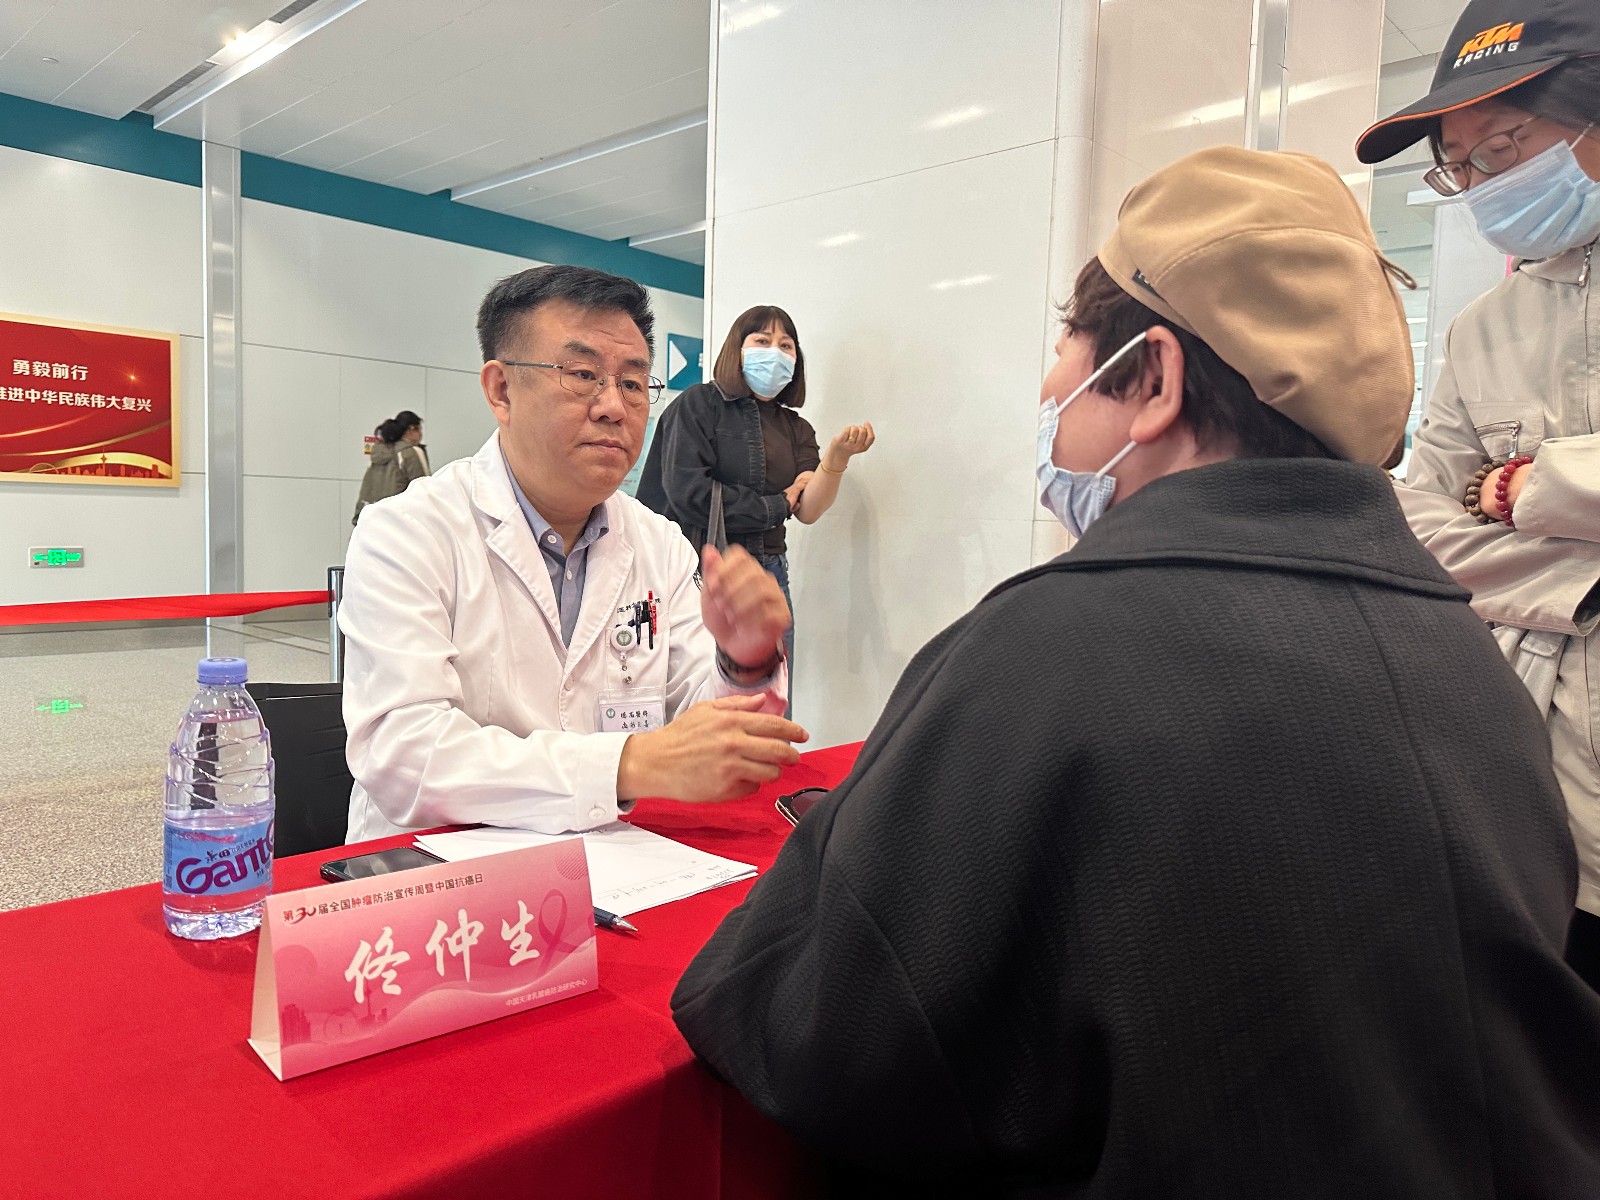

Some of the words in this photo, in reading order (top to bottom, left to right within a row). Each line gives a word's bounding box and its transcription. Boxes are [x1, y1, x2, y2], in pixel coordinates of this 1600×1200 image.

[1453, 41, 1519, 69] RACING
[1457, 22, 1524, 58] KTM
[12, 358, 89, 381] 勇毅前行
[344, 899, 540, 1004] 佟仲生
